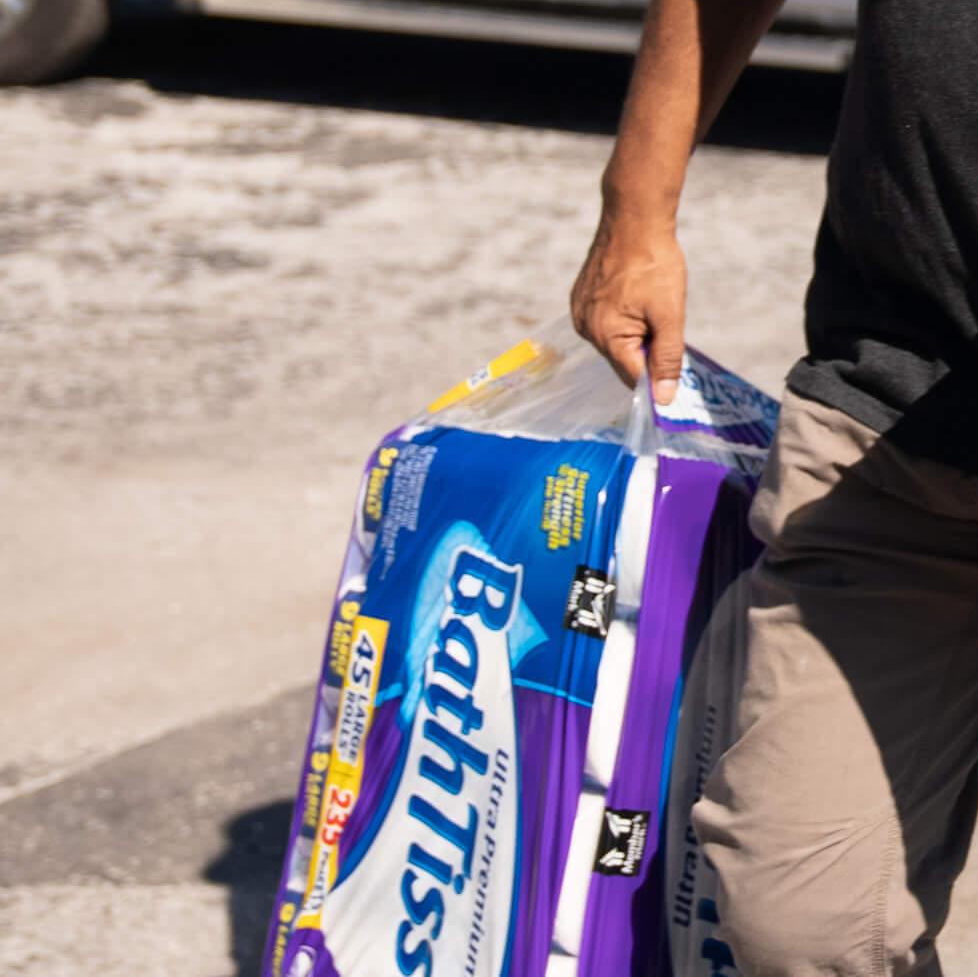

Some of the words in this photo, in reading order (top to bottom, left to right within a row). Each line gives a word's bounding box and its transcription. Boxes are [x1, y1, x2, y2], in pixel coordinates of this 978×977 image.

[352, 634, 375, 690] 45
[321, 788, 351, 846] 235
[484, 749, 510, 823] Ultra
[672, 851, 698, 928] Ultra
